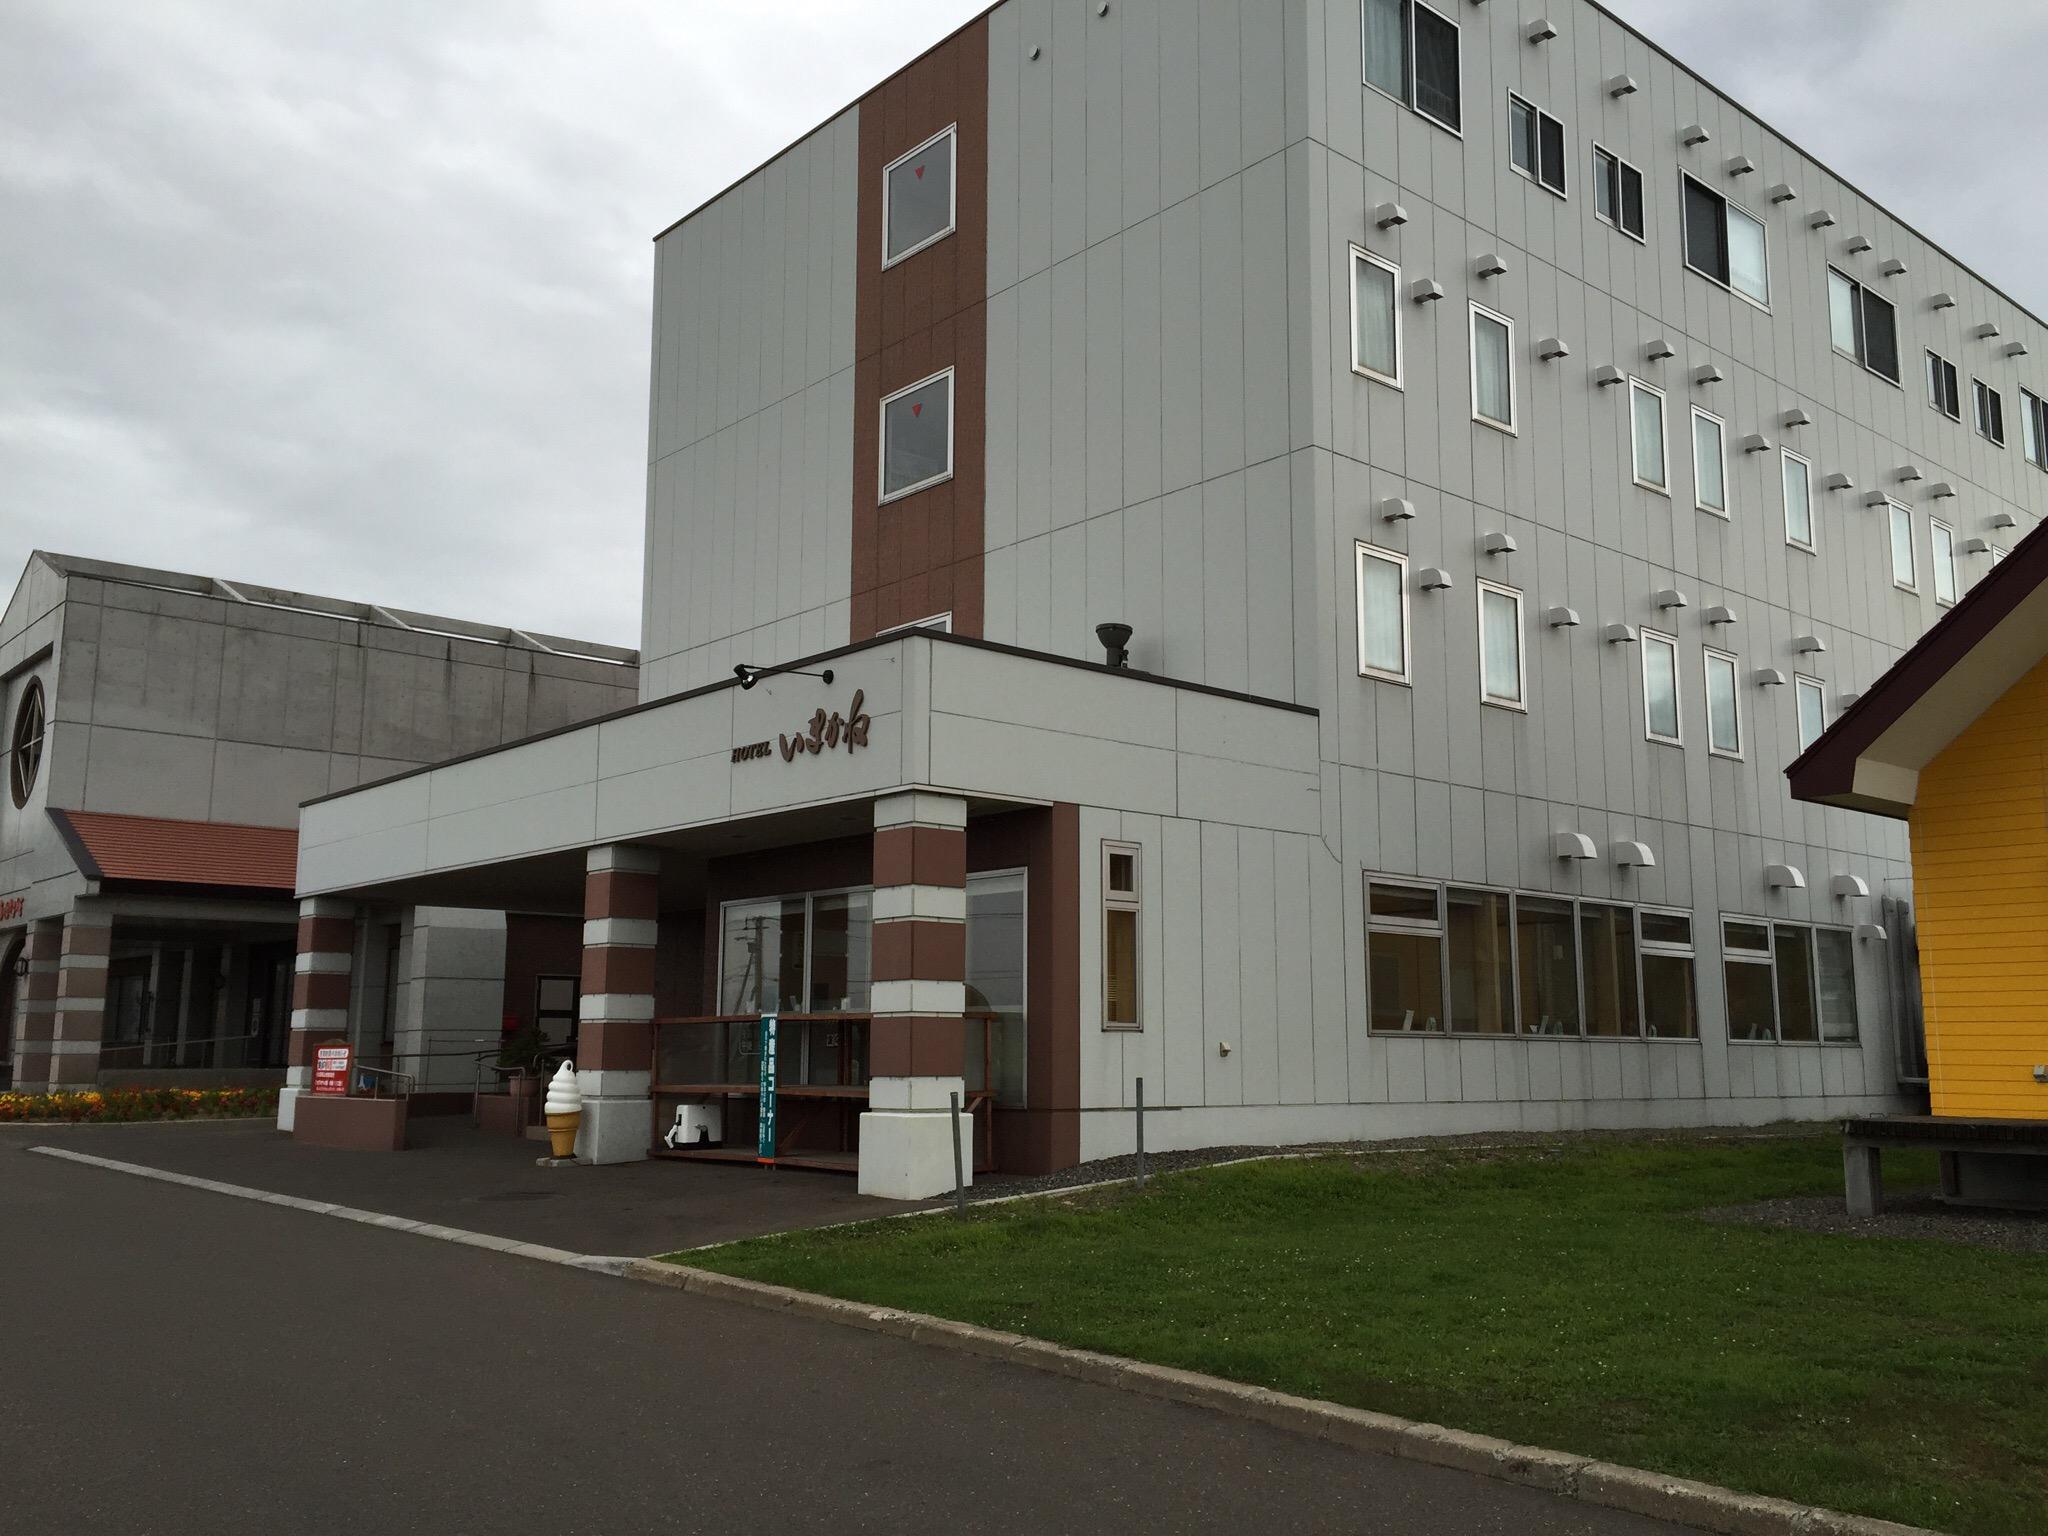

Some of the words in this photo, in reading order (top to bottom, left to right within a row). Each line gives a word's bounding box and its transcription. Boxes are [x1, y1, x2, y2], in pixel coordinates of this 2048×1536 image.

[779, 688, 871, 763] いまかね
[731, 741, 772, 763] HOTEL
